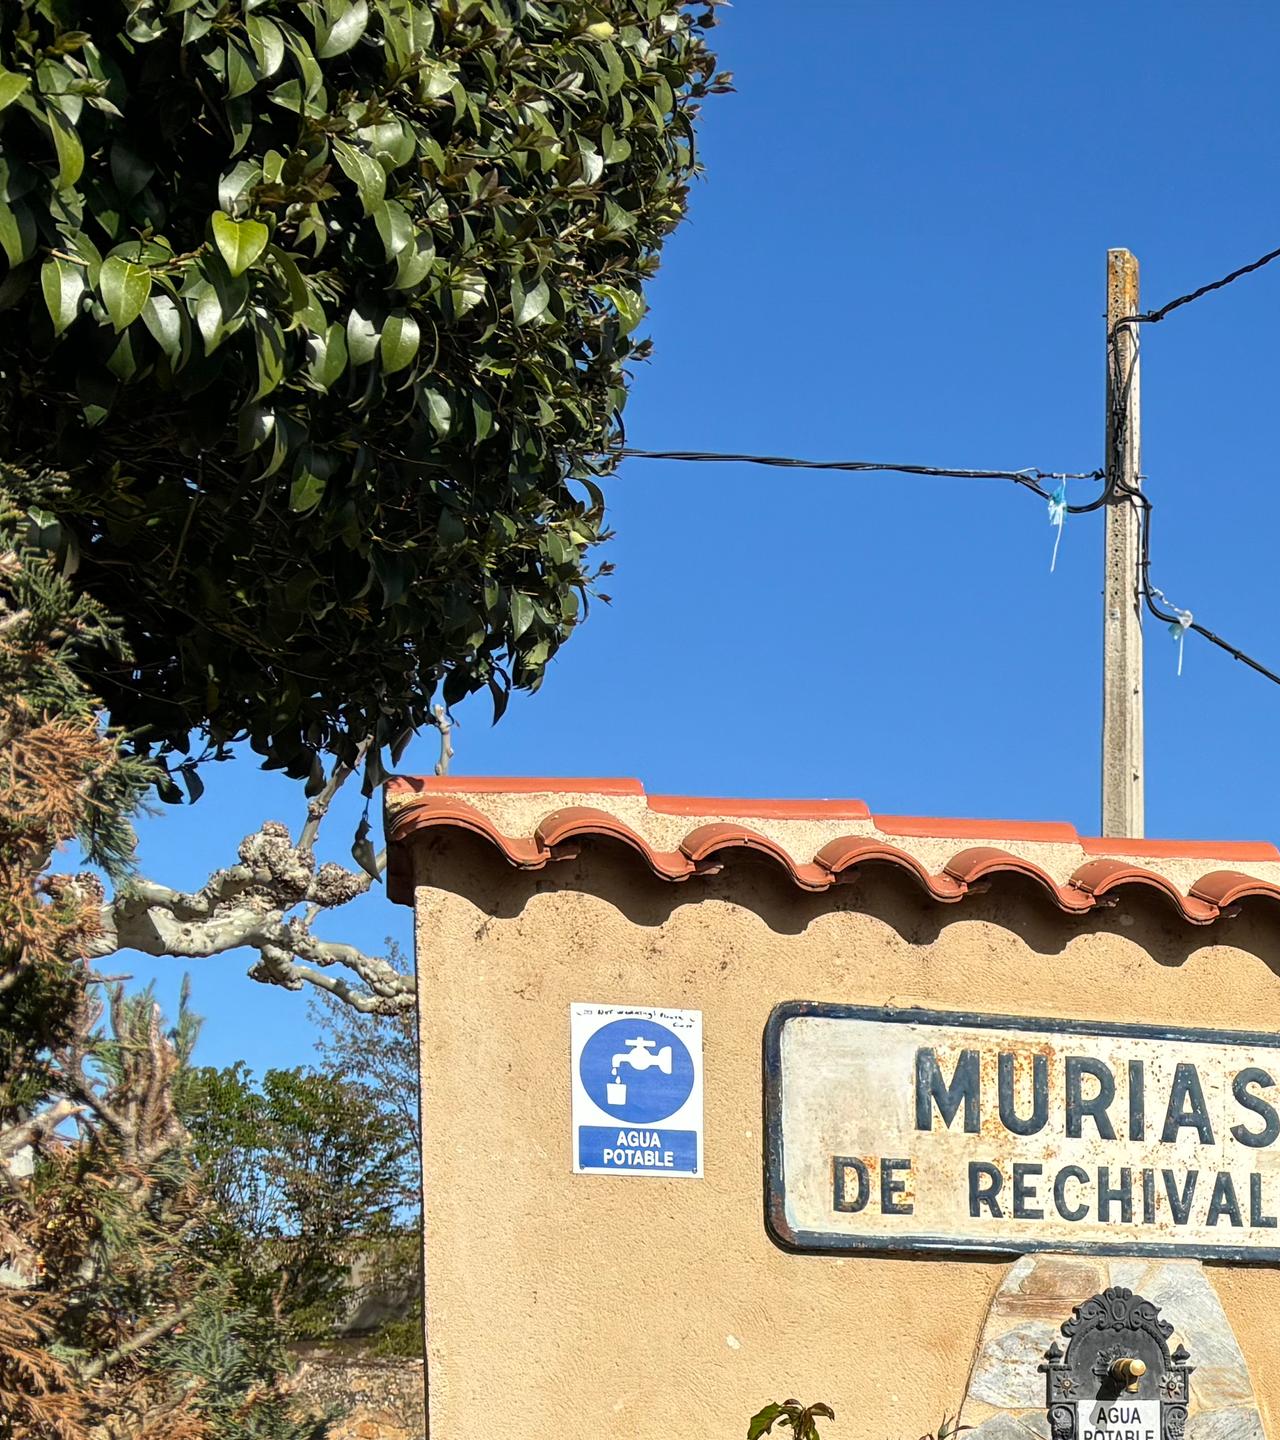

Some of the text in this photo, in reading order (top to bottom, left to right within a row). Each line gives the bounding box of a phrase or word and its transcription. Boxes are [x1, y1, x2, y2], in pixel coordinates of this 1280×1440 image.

[915, 1046, 1280, 1149] MURIAS
[616, 1130, 662, 1148] AGUA
[603, 1149, 674, 1167] POTABLE
[832, 1156, 915, 1216] DE
[1096, 1407, 1141, 1424] AGUA
